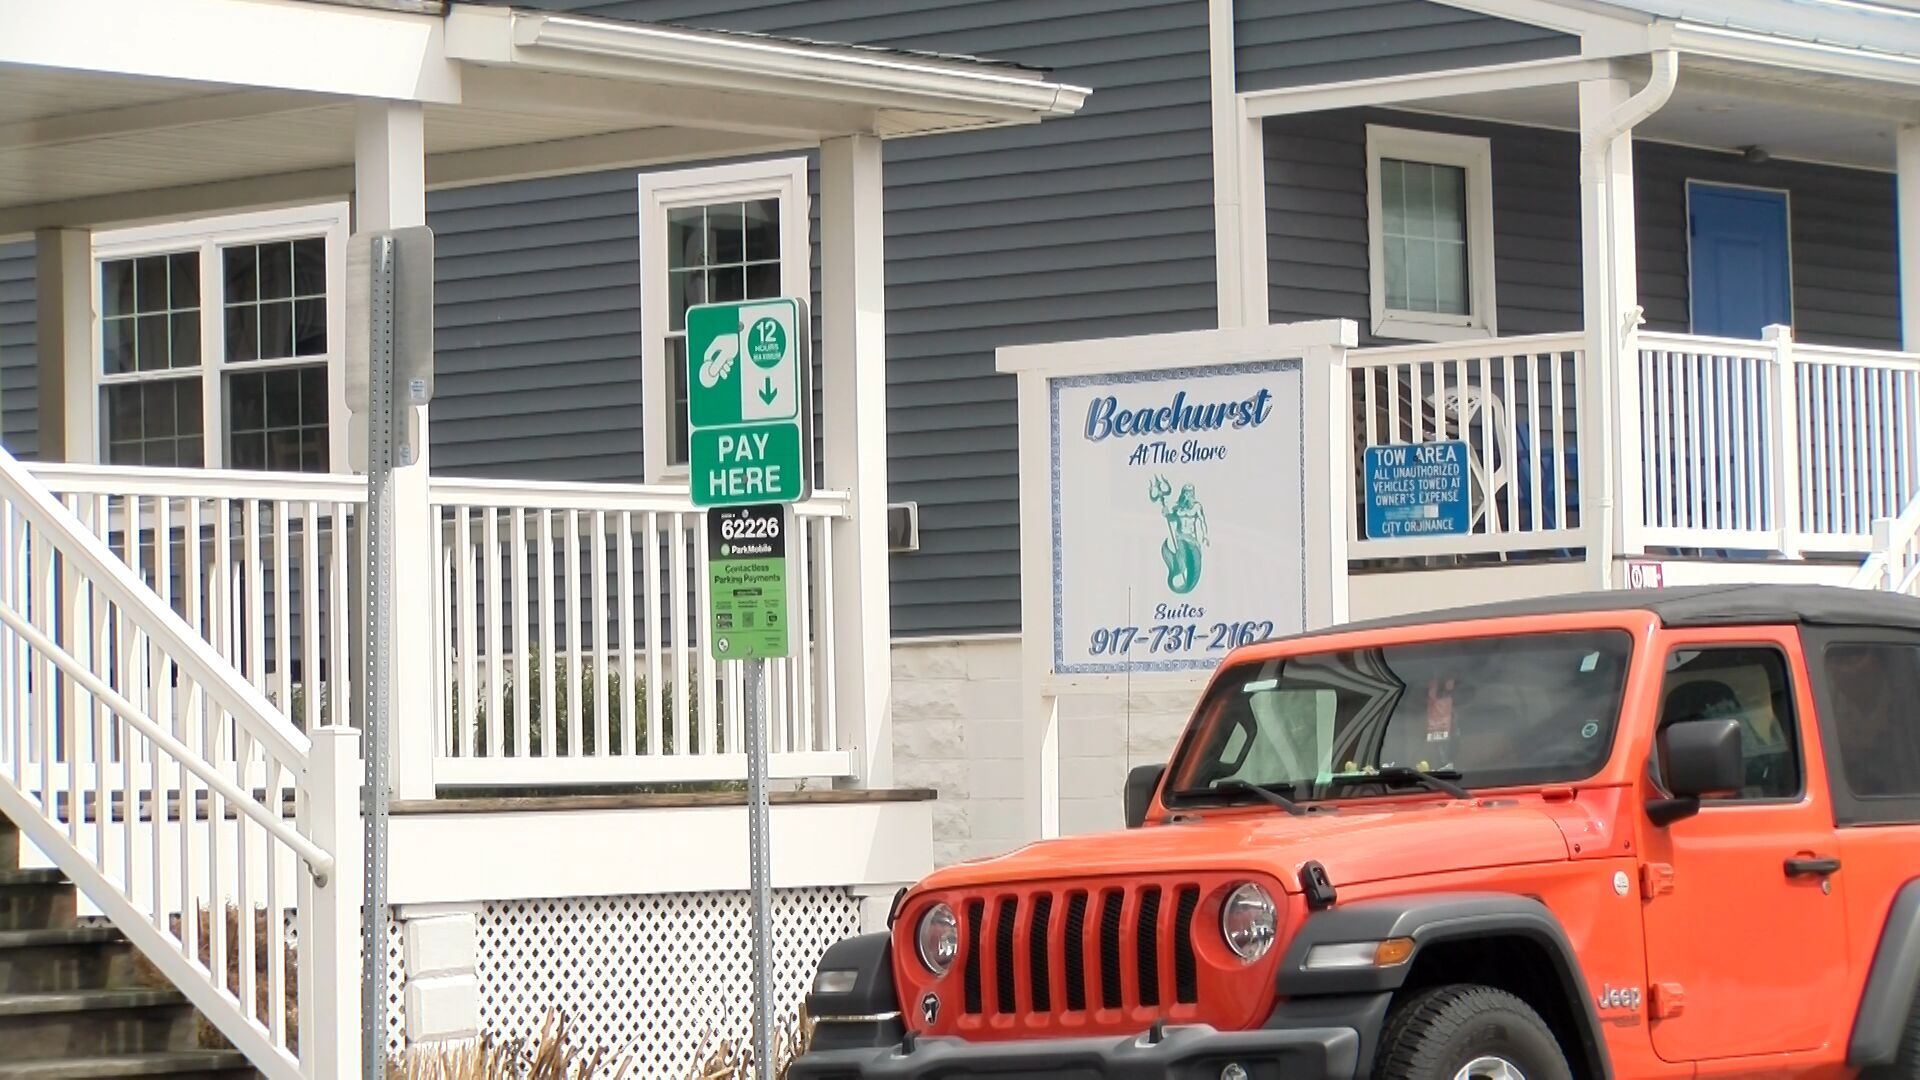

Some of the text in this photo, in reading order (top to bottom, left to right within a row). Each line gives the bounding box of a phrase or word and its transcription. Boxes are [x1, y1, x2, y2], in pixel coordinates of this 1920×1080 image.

[757, 320, 778, 342] 12
[1084, 388, 1273, 442] Beachurst
[718, 432, 769, 463] PAY
[1129, 439, 1227, 466] At The Shore
[1375, 446, 1457, 466] TOW AREA
[709, 465, 782, 496] HERE
[1374, 464, 1460, 480] ALL UNAUTHORIZED
[1373, 477, 1461, 493] VEHICLES TOWED AT
[1375, 490, 1459, 506] OWNER'S EXPENSE
[721, 517, 779, 540] 62226
[1382, 518, 1454, 534] CITY ORDINANCE
[714, 573, 780, 585] Parking Payments
[725, 563, 770, 574] Contactless
[1154, 602, 1205, 620] Suites
[1088, 620, 1274, 656] 917-731-2162
[1598, 983, 1641, 1011] Jeep
